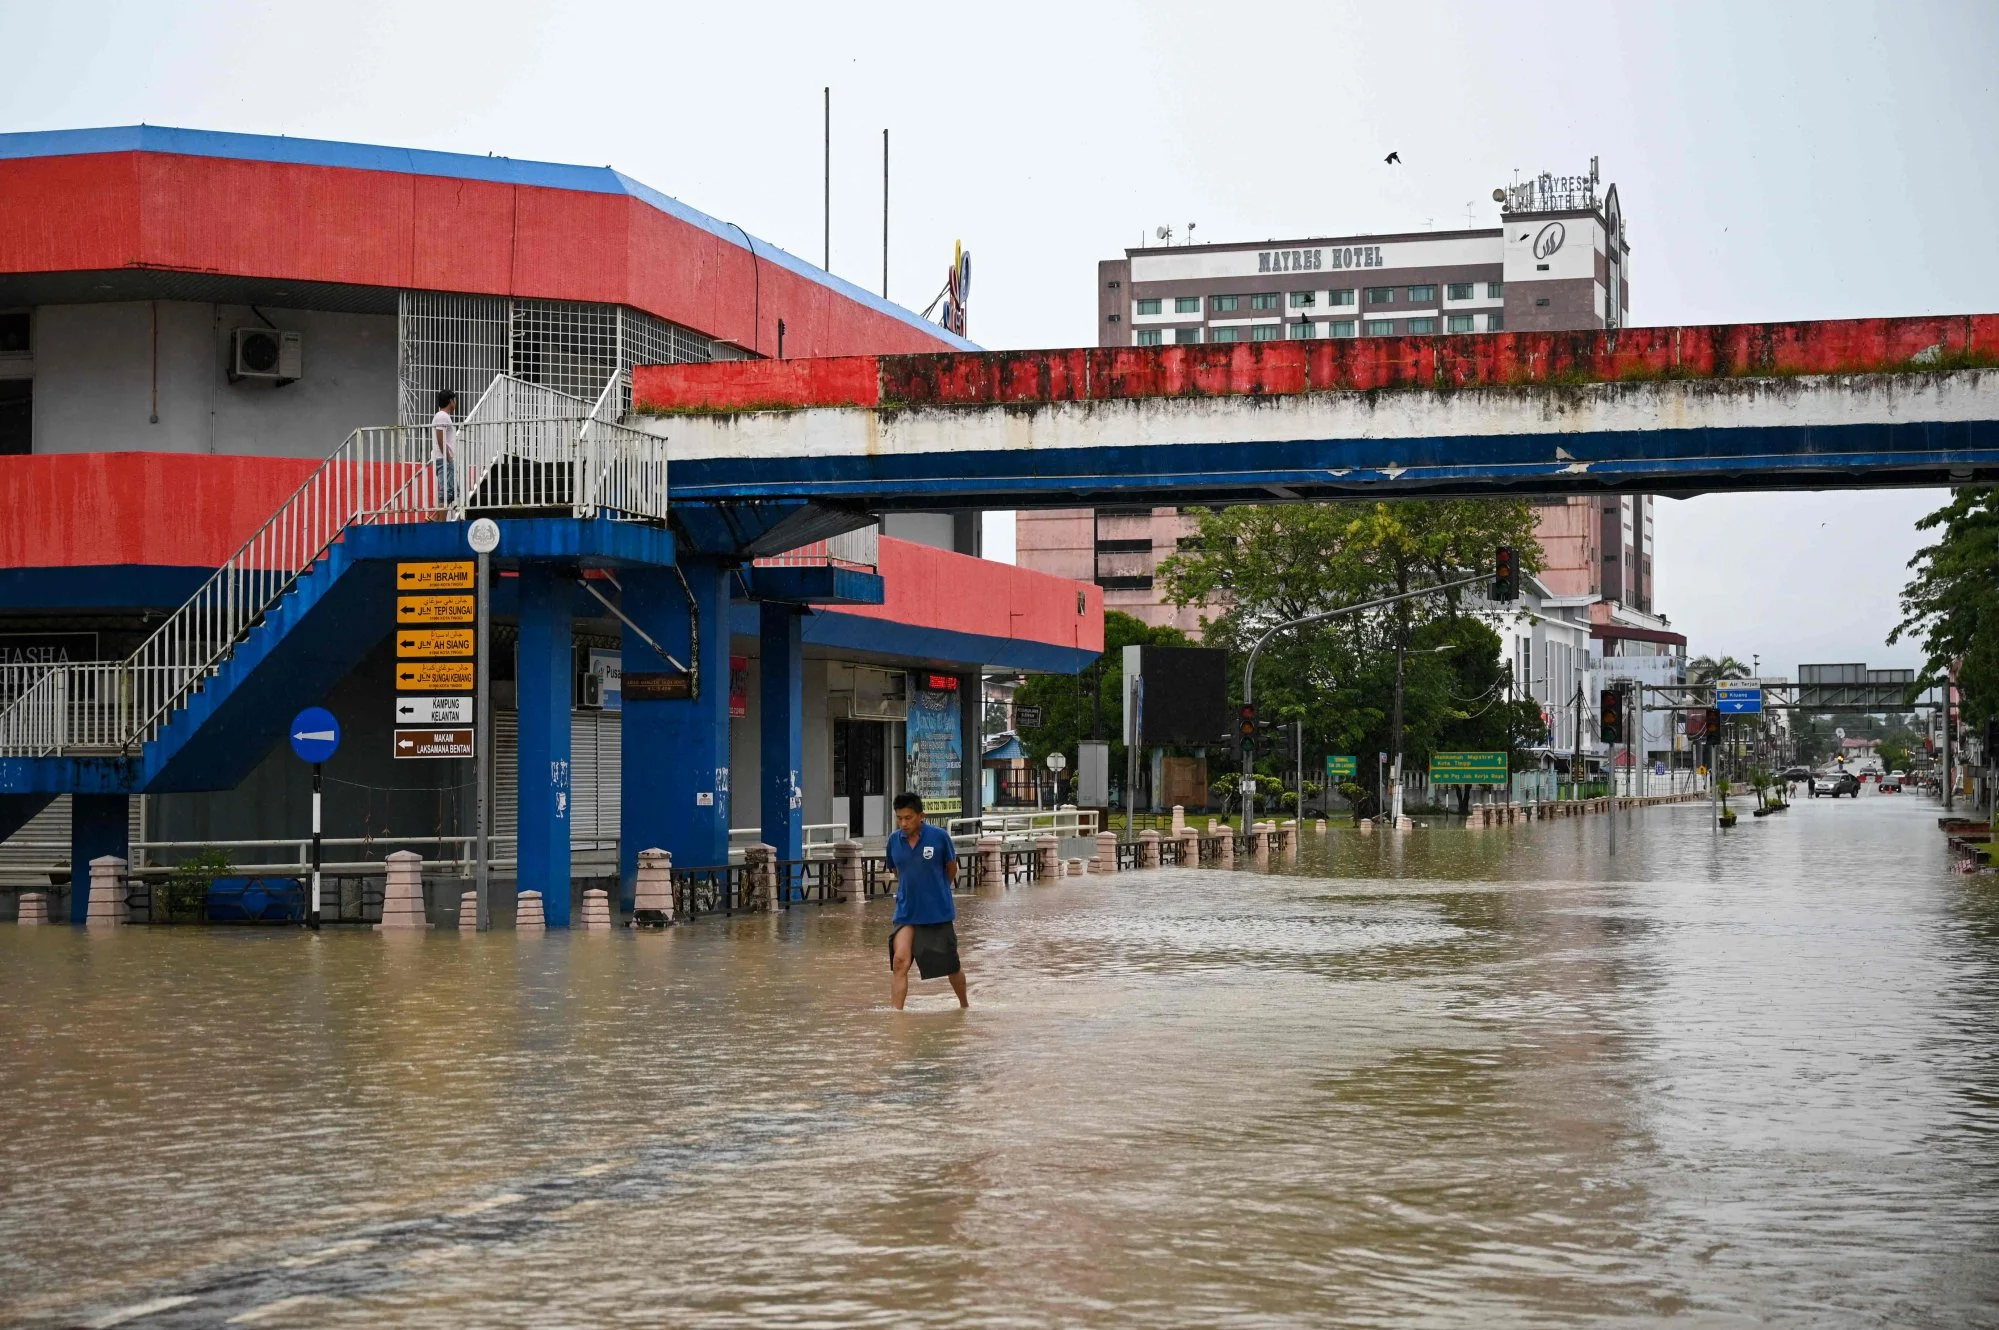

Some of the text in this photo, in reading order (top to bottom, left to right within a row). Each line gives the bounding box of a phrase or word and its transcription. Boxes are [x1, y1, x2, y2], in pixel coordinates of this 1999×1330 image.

[1538, 175, 1582, 193] MAYRES
[1258, 246, 1383, 273] MAYRES HOTEL
[434, 572, 468, 582] IBRAHIM
[434, 606, 448, 616] TEPI
[449, 605, 473, 615] SUNGAI
[434, 640, 445, 650] AH
[446, 640, 470, 649] SIANG
[432, 673, 450, 682] SUNGAI
[451, 673, 472, 682] KEMANG
[433, 699, 460, 709] KAMPUNG
[431, 711, 460, 721] KELANTAN
[434, 733, 454, 743] MAKAM
[417, 744, 471, 754] LAKSAMANA BENTAN
